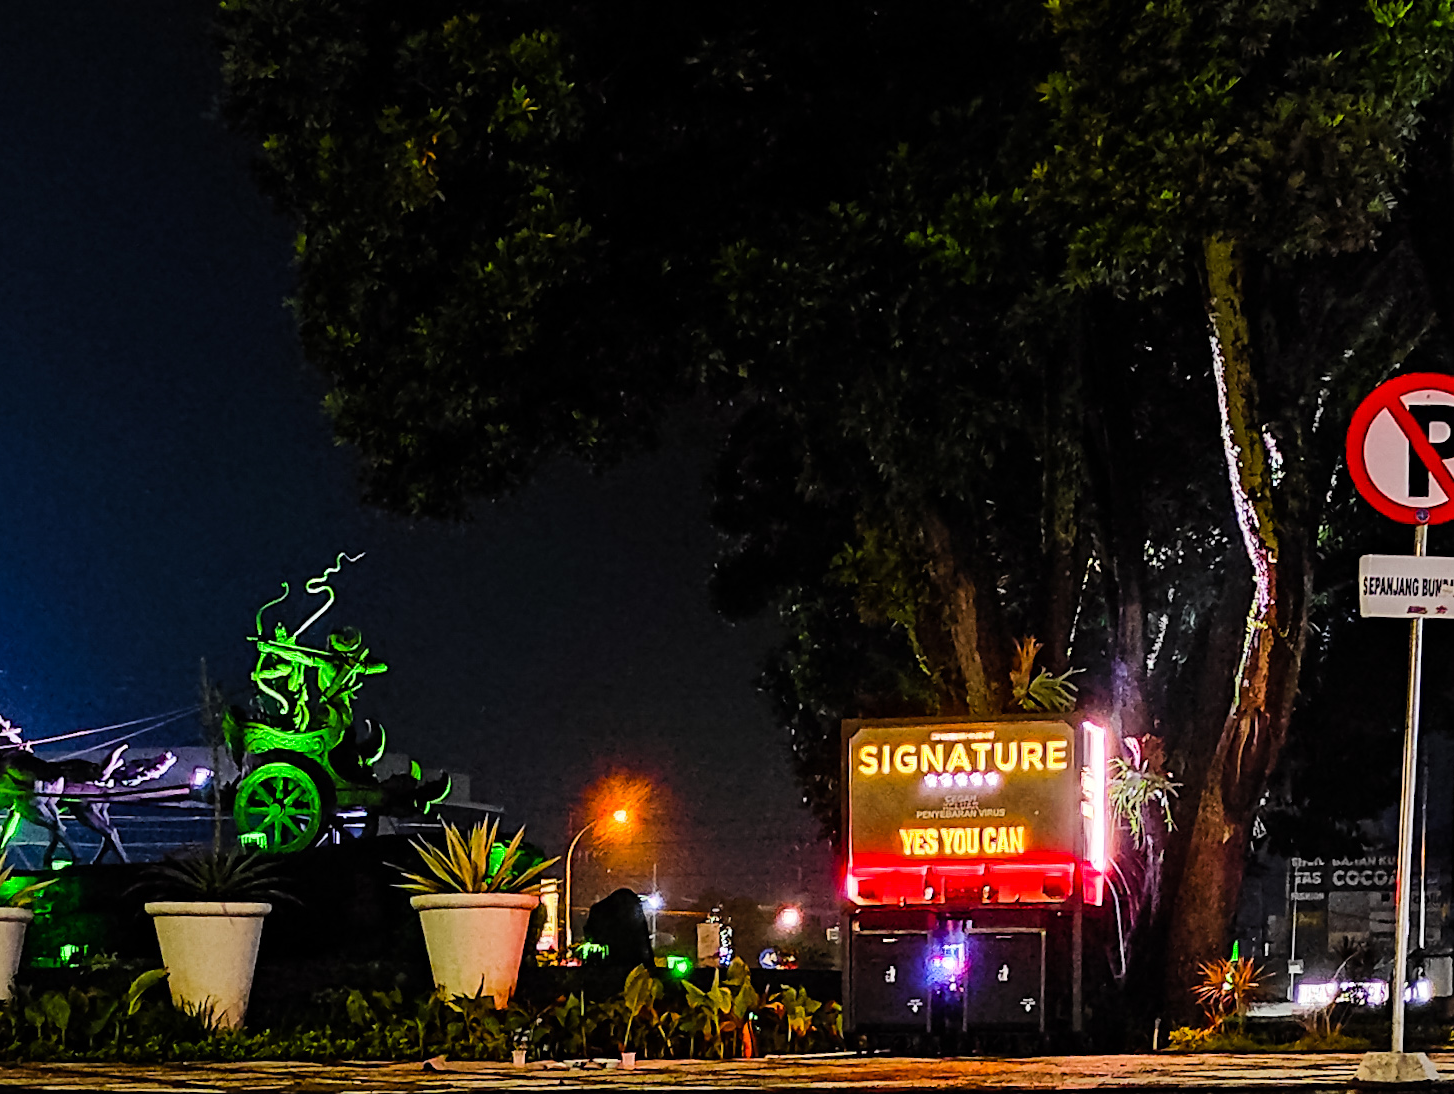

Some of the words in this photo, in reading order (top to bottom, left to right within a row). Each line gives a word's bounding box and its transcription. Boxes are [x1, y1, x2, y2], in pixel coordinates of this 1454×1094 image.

[1363, 576, 1419, 597] SEPANJANG
[858, 740, 1068, 775] SIGNATURE
[916, 809, 977, 819] PENYEBARAN
[978, 807, 1006, 817] VIRUS
[898, 827, 940, 856] YES
[940, 826, 981, 855] YOU
[982, 825, 1025, 855] CAN
